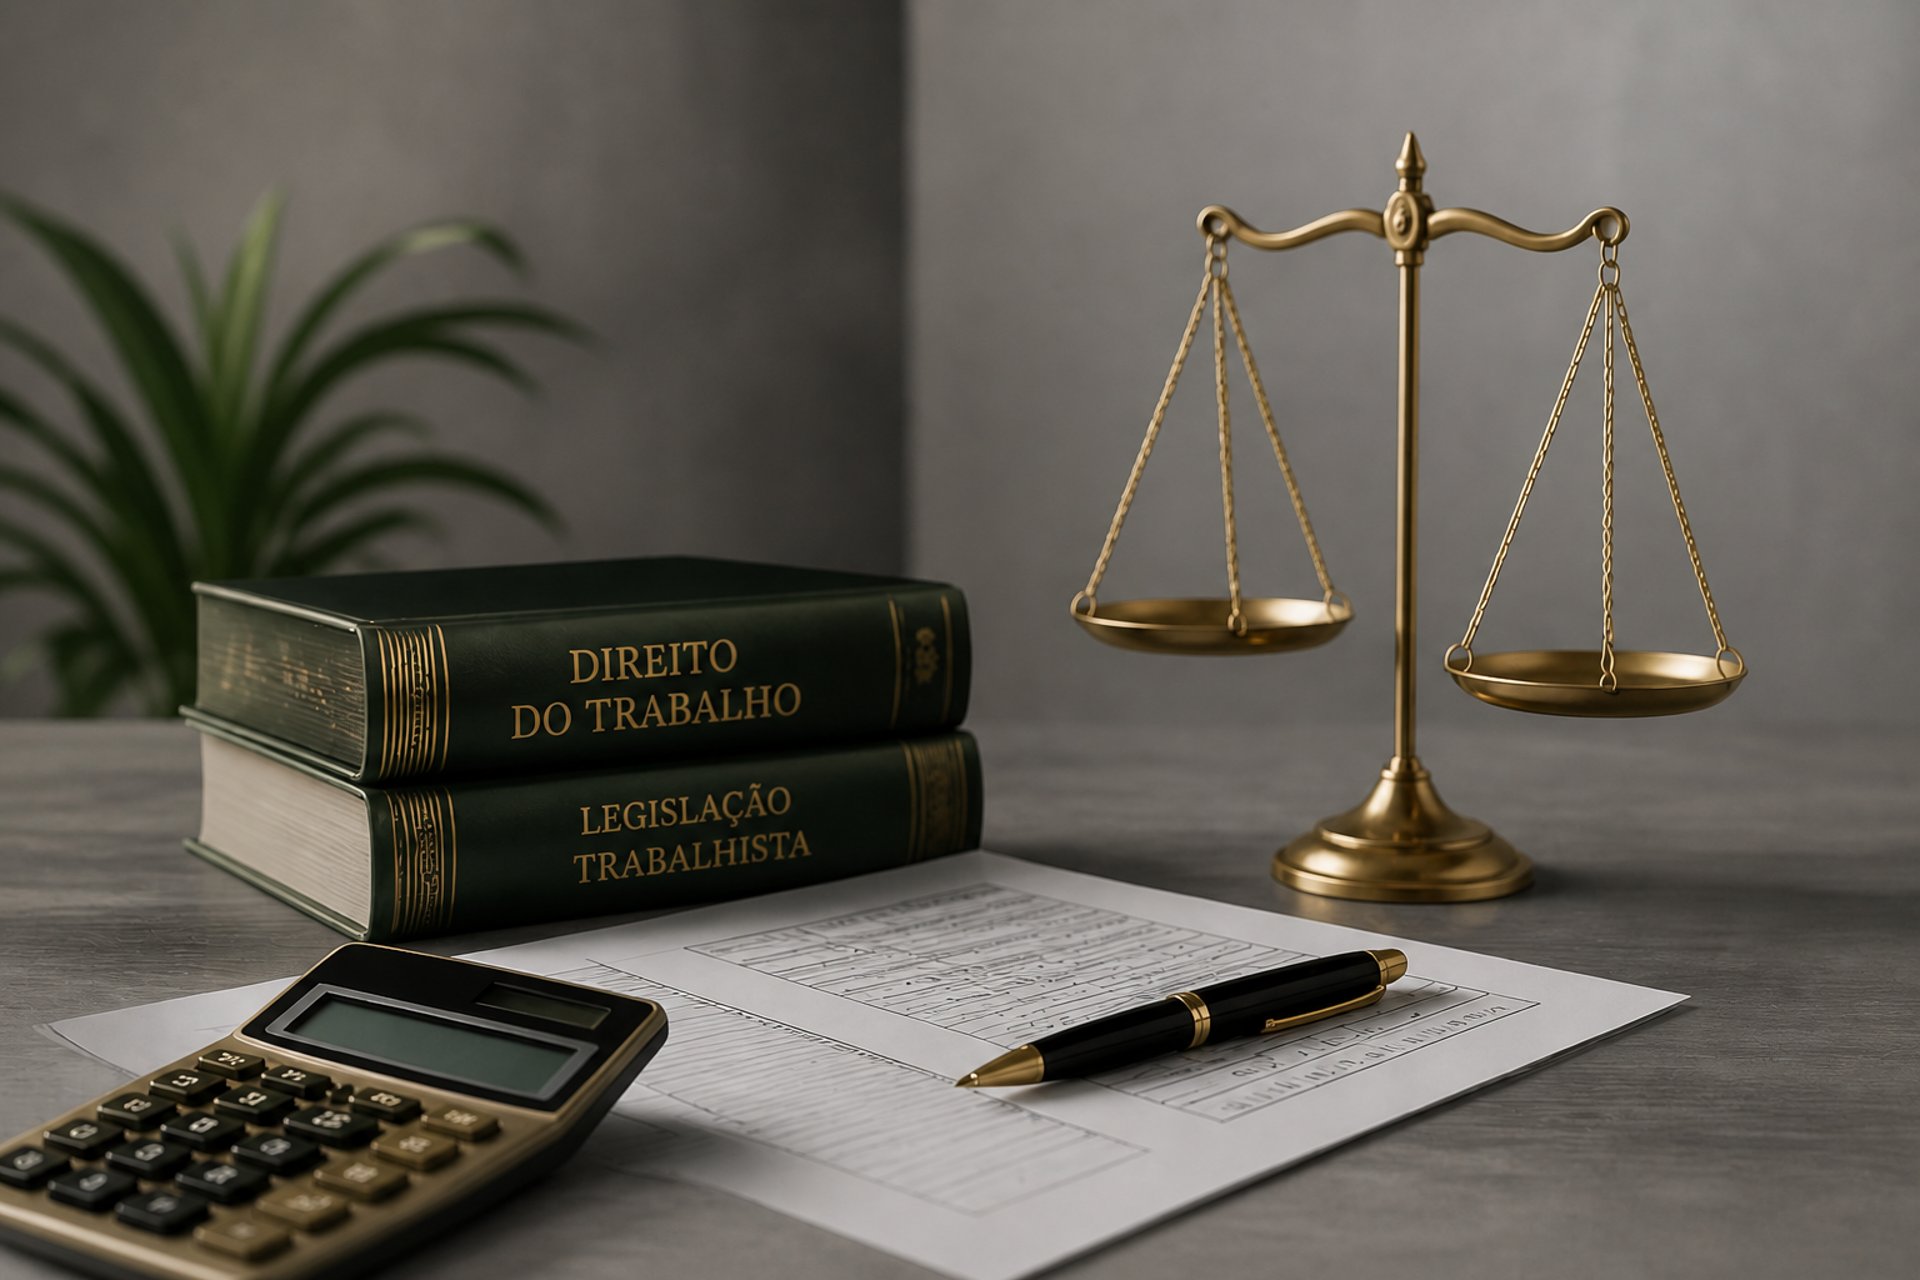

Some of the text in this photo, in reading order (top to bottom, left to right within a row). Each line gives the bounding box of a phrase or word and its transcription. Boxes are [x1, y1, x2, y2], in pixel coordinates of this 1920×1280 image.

[569, 639, 738, 684] DIREITO
[511, 683, 802, 739] DO TRABALHO
[580, 783, 792, 835] LEGISLAÇÃO
[573, 831, 812, 883] TRABALHISTA
